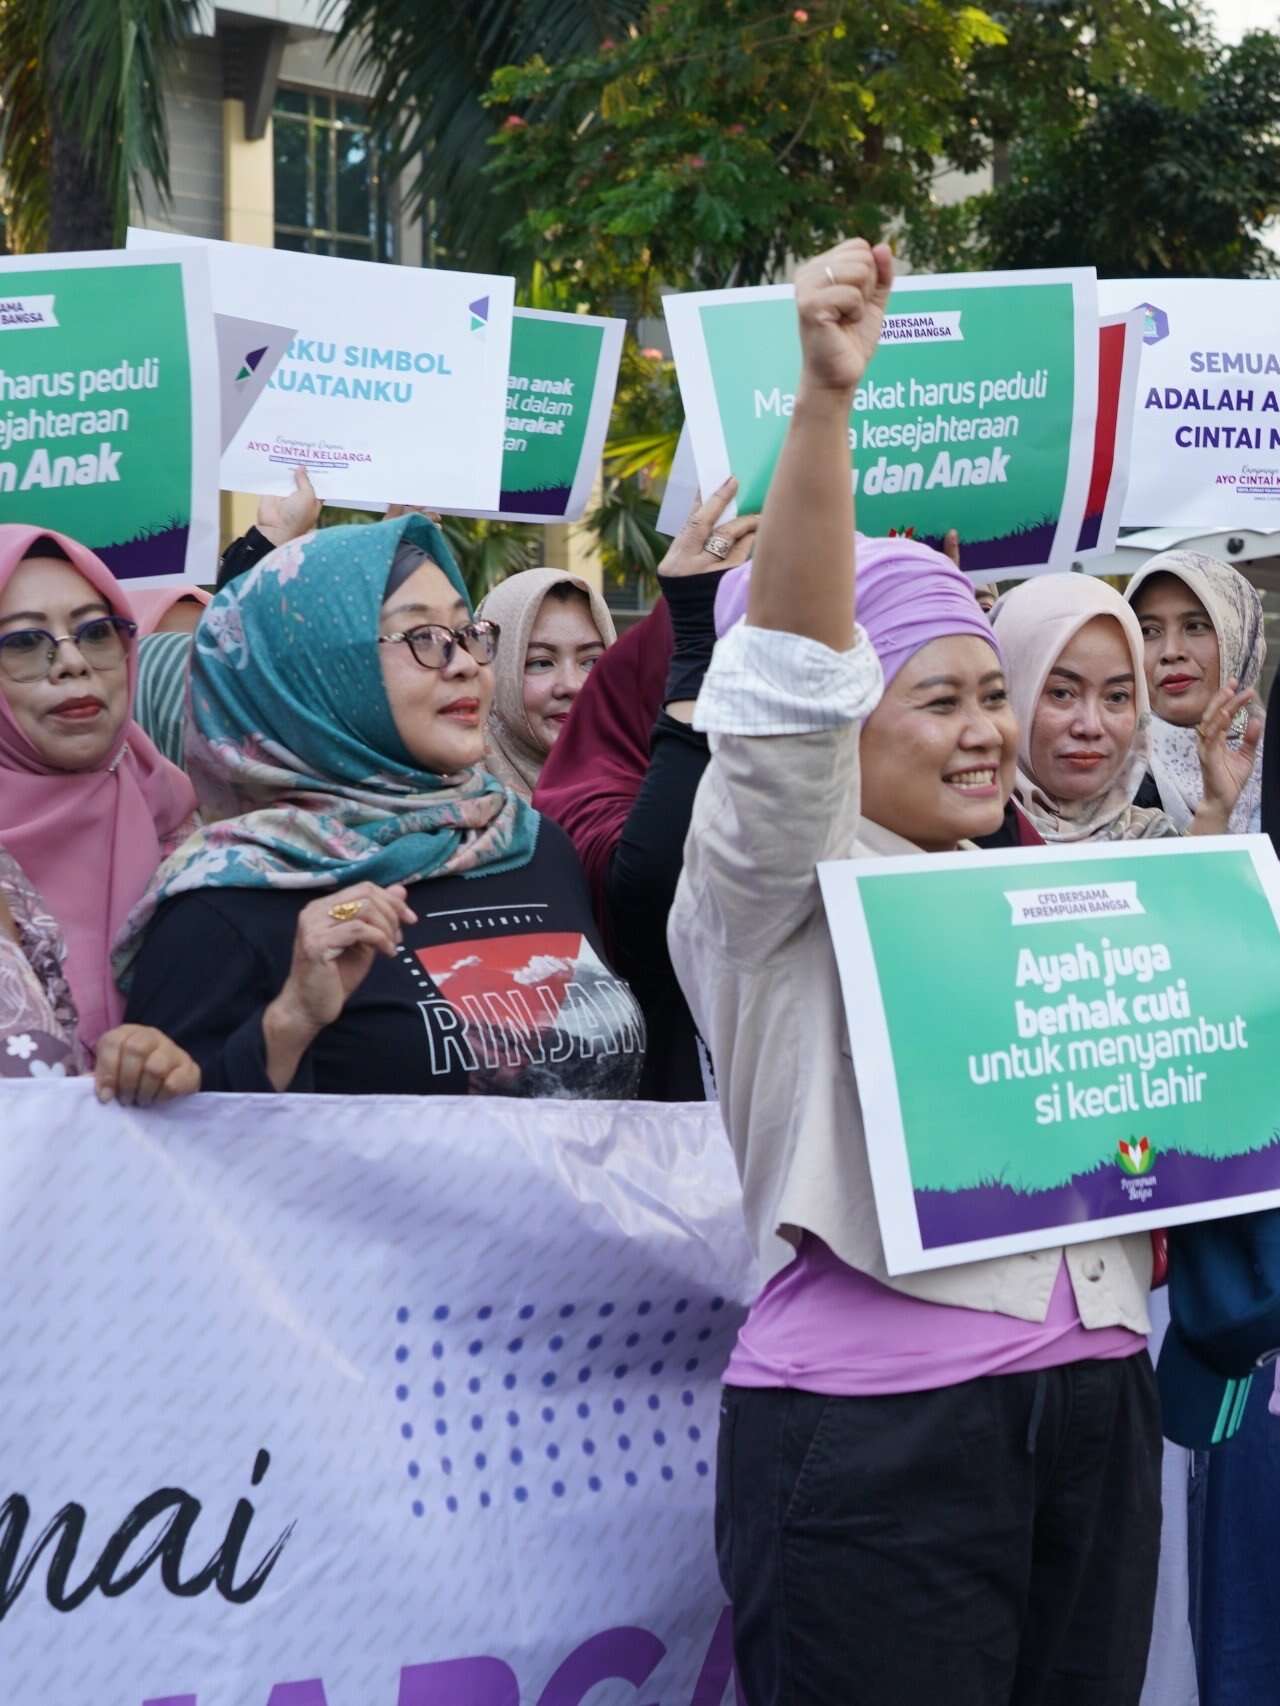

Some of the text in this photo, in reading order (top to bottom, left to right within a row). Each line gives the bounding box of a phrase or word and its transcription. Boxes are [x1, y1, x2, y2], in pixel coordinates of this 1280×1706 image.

[889, 317, 934, 329] BERSAMA
[914, 327, 952, 338] BANGSA
[344, 345, 452, 375] SIMBOL
[79, 357, 160, 401] peduli
[530, 378, 575, 396] anak
[909, 377, 975, 408] harus
[979, 369, 1049, 409] peduli
[521, 395, 573, 416] dalam
[1145, 388, 1254, 411] ADALAH
[863, 415, 1018, 452] kesejahteraan
[1175, 425, 1261, 450] CINTAI
[248, 440, 270, 452] AYO
[272, 444, 310, 458] CINTAI
[313, 450, 372, 463] KELUARGA
[19, 442, 123, 491] Anak
[863, 457, 924, 496] dan
[925, 447, 1011, 491] Anak
[1215, 475, 1236, 485] AYO
[1239, 475, 1274, 486] CINTAI
[1022, 899, 1131, 919] PEREMPUAN BANGSA
[1037, 889, 1110, 905] CFD BERSAMA
[1015, 937, 1172, 992] Ayah juga
[1016, 977, 1191, 1038] berhak cuti
[968, 1016, 1248, 1084] untuk menyambut
[1035, 1065, 1208, 1125] si kecil lahir
